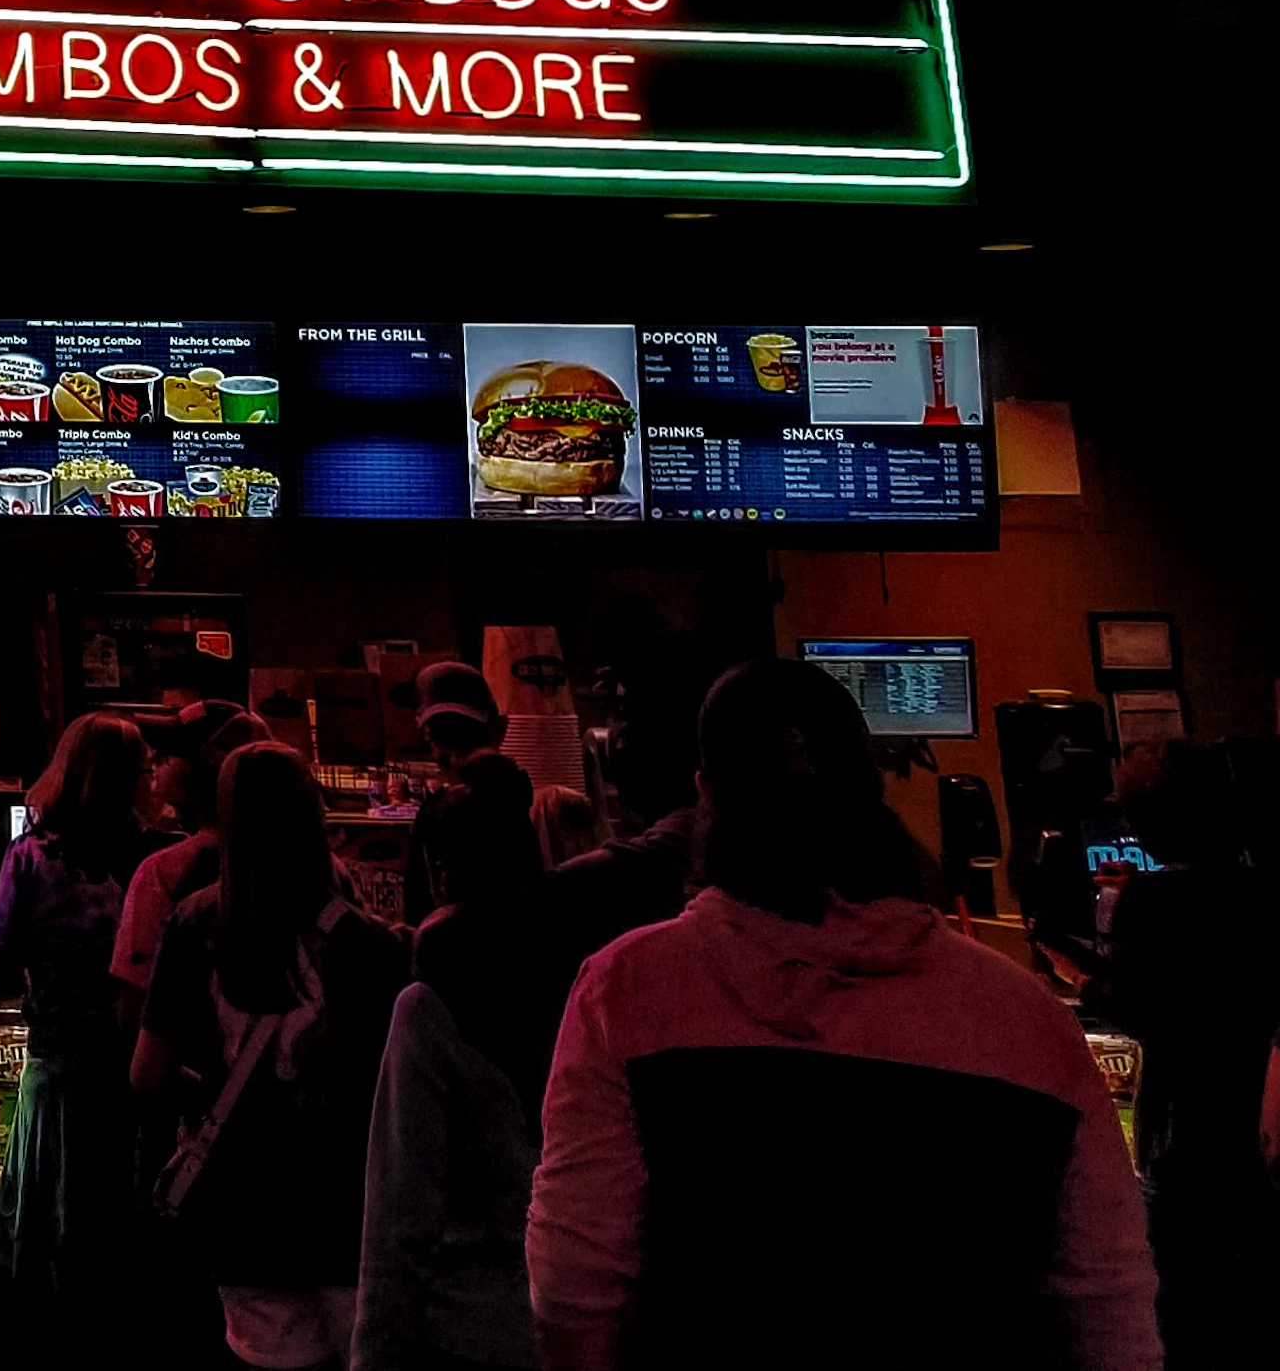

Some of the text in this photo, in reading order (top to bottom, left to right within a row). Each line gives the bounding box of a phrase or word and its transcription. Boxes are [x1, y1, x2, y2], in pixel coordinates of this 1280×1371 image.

[292, 41, 345, 114] &
[386, 49, 643, 122] MORE
[298, 328, 426, 341] FROM THE GRILL
[642, 332, 718, 345] POPCORN
[810, 331, 855, 339] because
[56, 335, 141, 347] Hot Dog Combo
[170, 336, 251, 346] Nachos Combo
[812, 343, 832, 352] you
[834, 342, 872, 352] belong
[58, 430, 131, 440] Triple Combo
[173, 431, 241, 441] Kid's Combo
[648, 426, 705, 438] DRINKS
[782, 428, 844, 441] SNACKS
